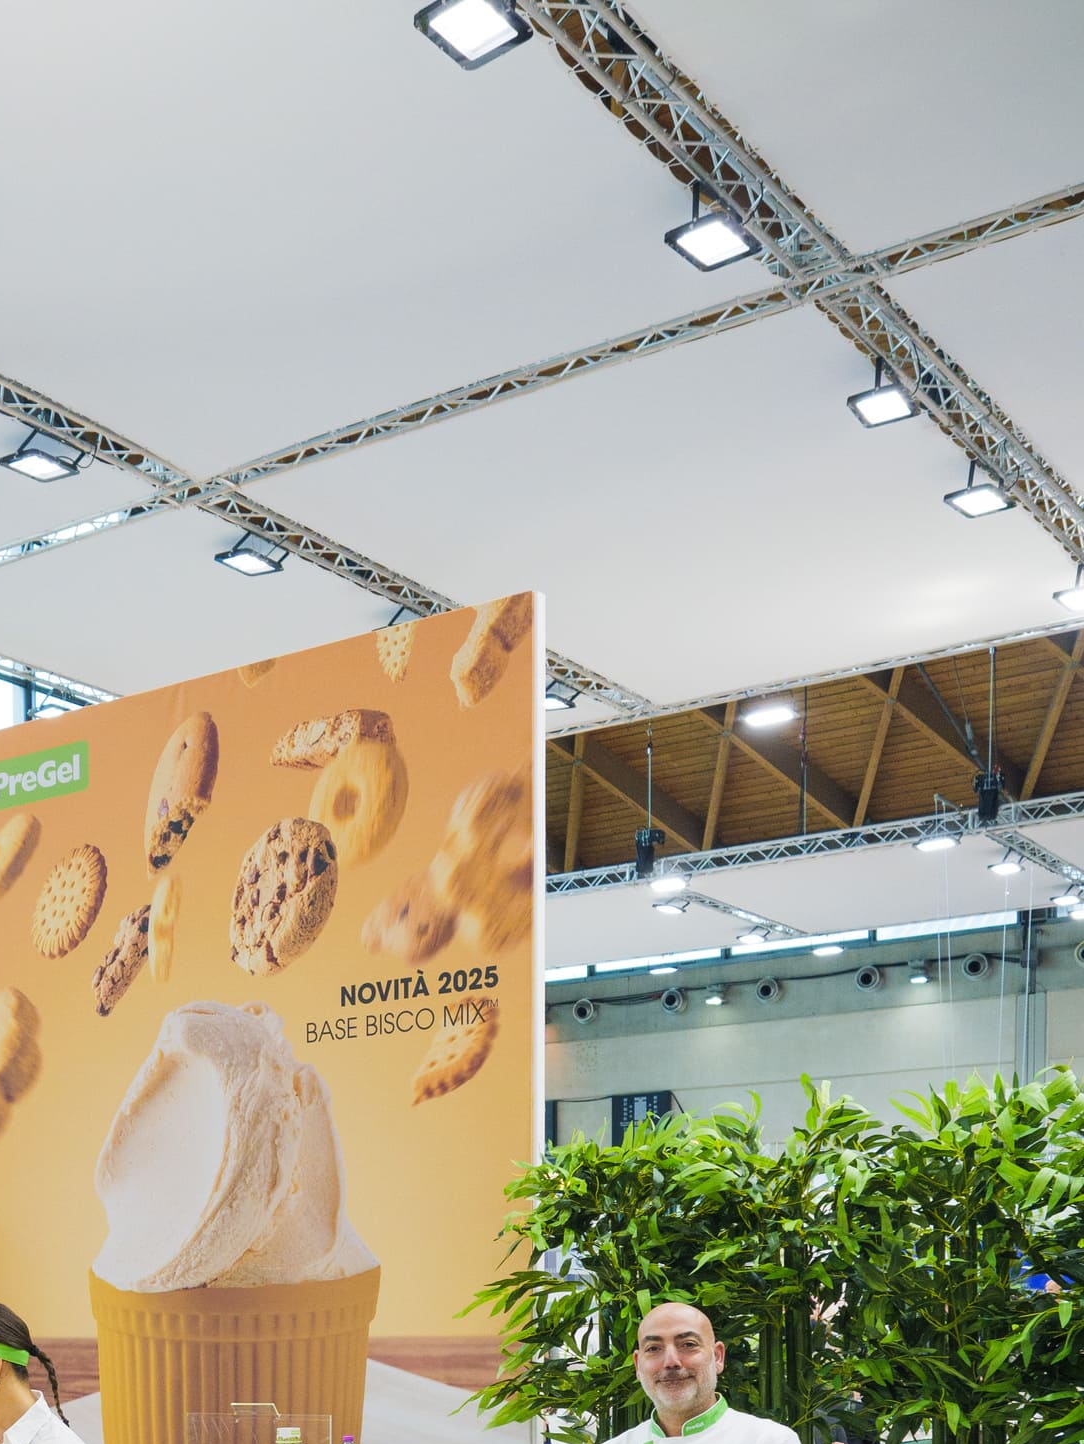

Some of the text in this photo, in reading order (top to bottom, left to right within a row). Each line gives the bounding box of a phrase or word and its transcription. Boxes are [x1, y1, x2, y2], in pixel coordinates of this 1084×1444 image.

[340, 965, 499, 1007] NOVITÀ 2025
[306, 1017, 358, 1043] BASE
[366, 1008, 435, 1036] BISCO
